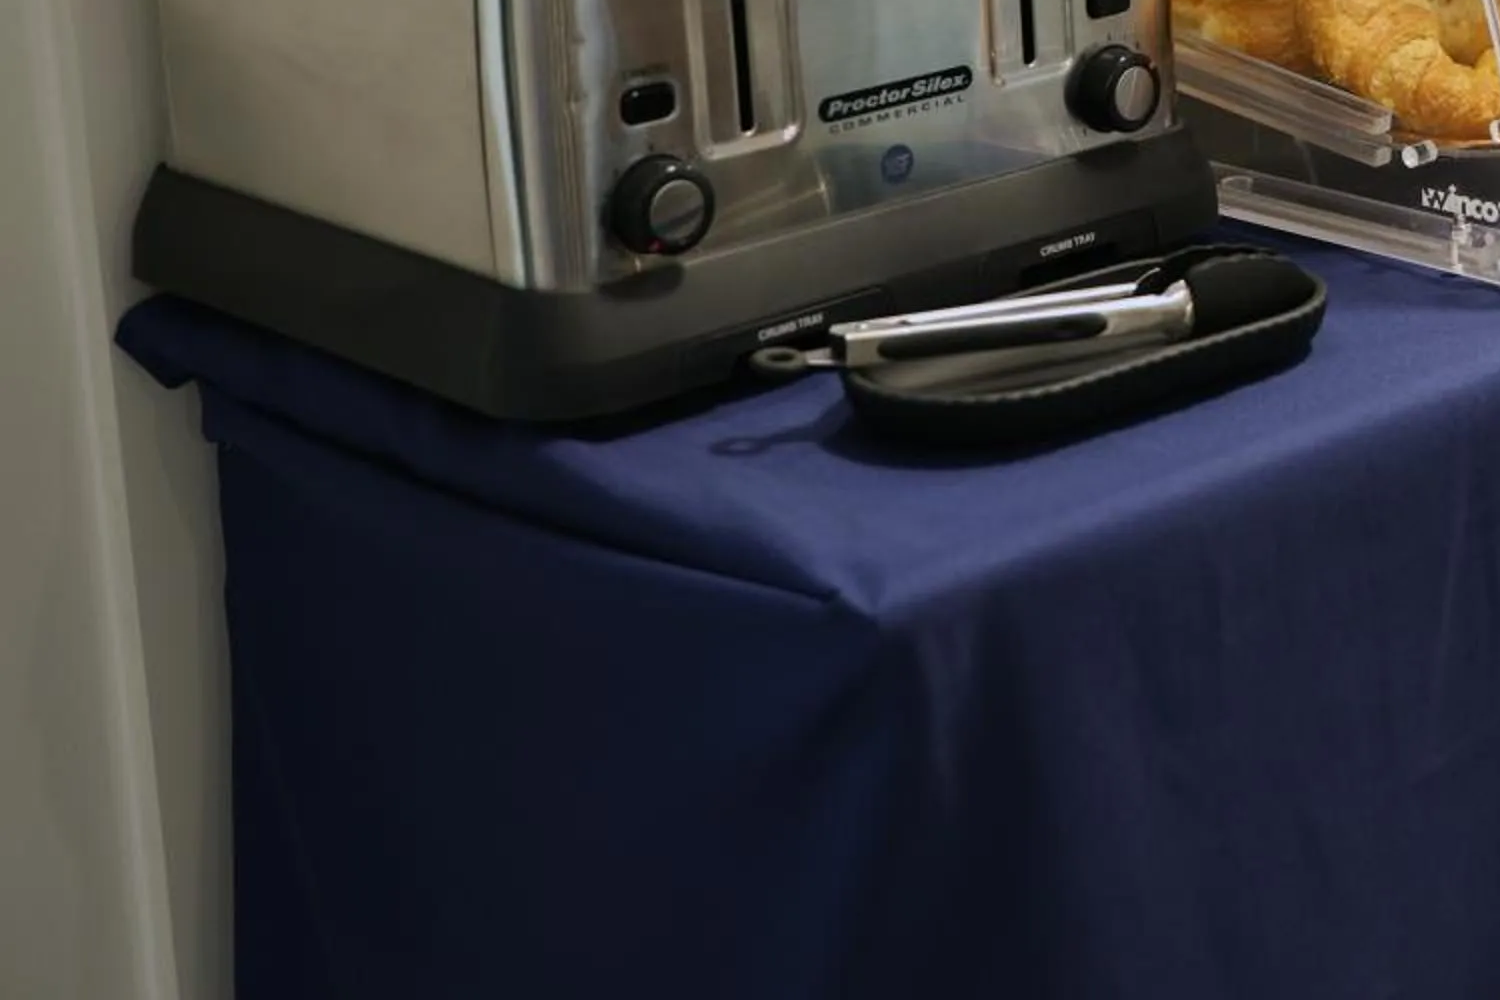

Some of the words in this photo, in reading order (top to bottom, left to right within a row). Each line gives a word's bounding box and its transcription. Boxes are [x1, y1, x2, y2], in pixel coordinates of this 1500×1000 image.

[829, 94, 965, 134] COMMERCIAL
[1040, 239, 1073, 258] CRUMB
[1073, 231, 1096, 247] TRAY
[758, 321, 798, 341] CRUMB
[799, 313, 824, 329] TRAY
